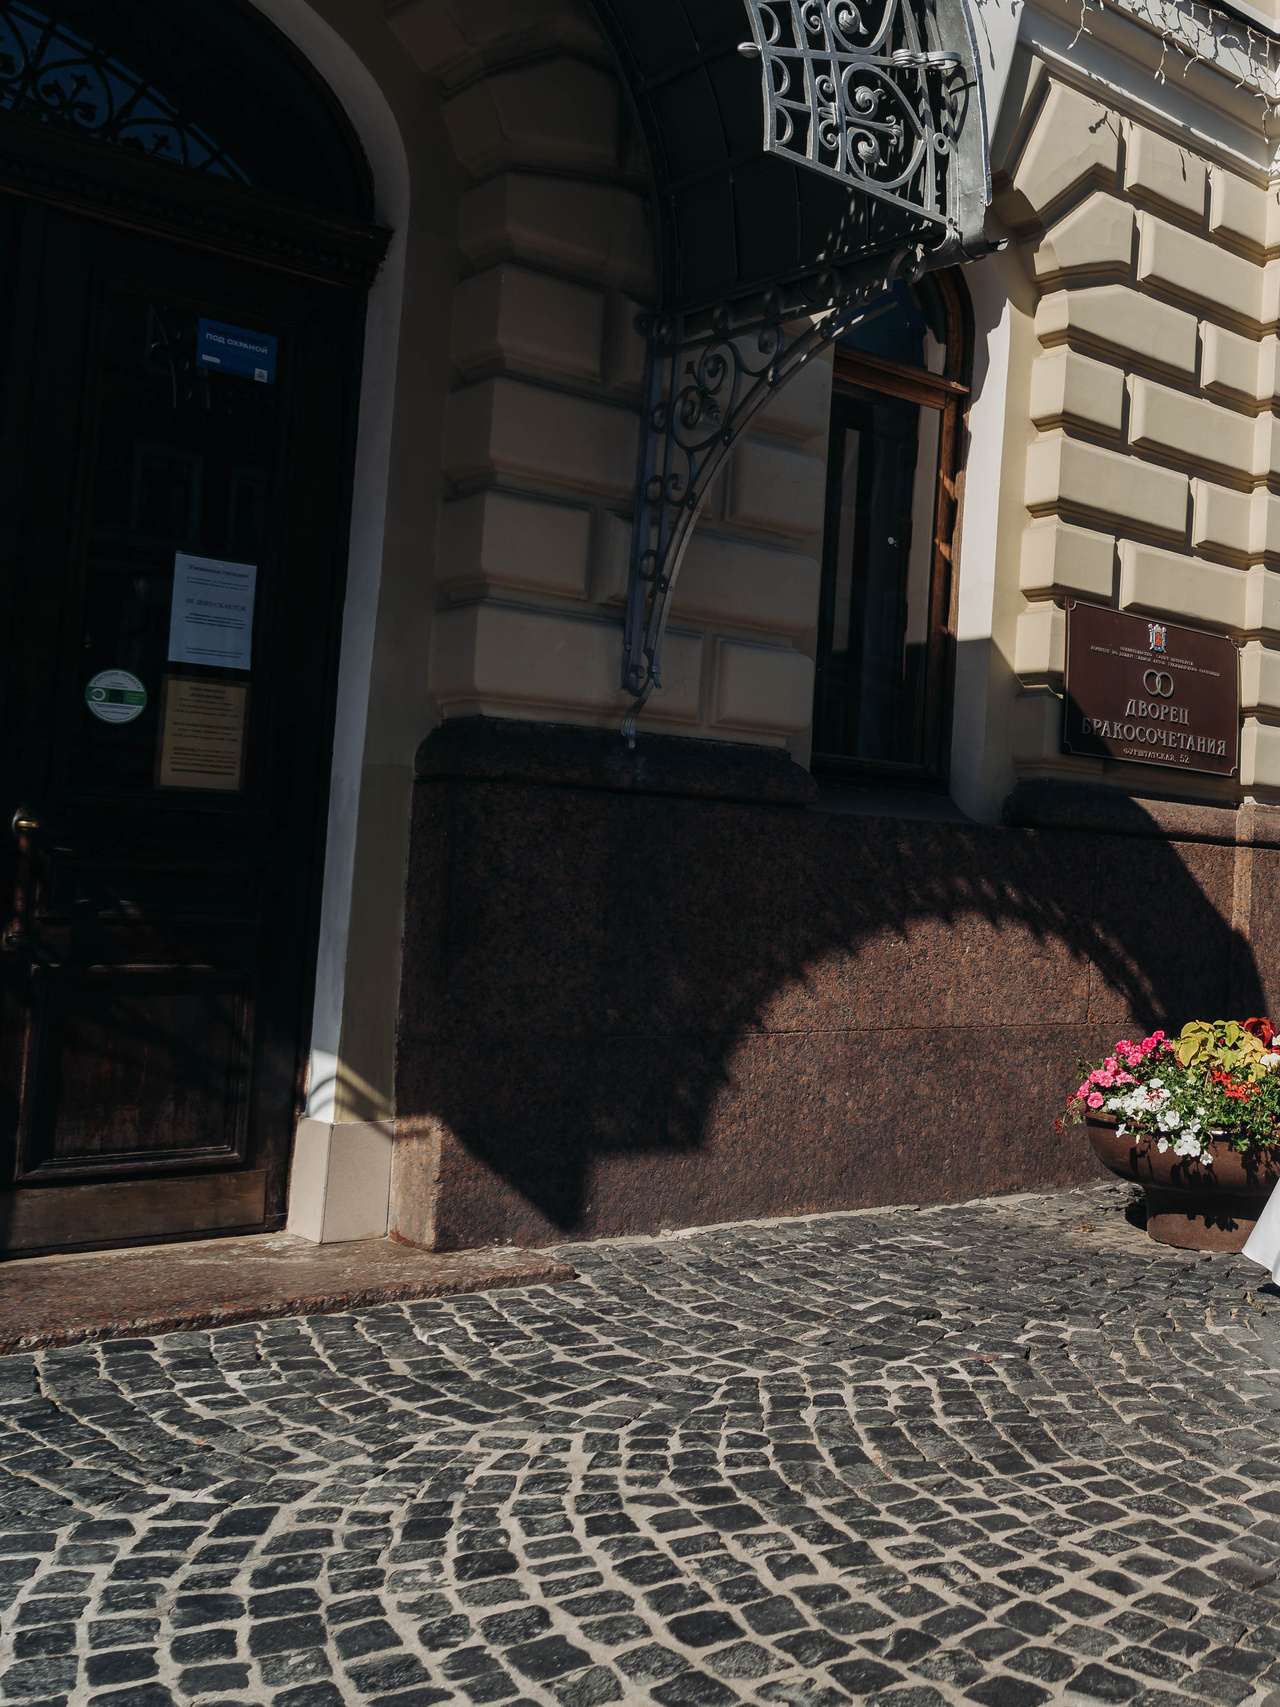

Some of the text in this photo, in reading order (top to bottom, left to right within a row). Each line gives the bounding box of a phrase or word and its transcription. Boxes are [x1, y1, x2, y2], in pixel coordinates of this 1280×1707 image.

[205, 333, 225, 344] ПОД
[227, 339, 268, 354] ОХРАНОЙ
[1125, 698, 1190, 727] ДВОРЕЦ
[1081, 716, 1227, 757] БРАКОСОЧЕТАНИЯ
[1179, 754, 1190, 765] 52
